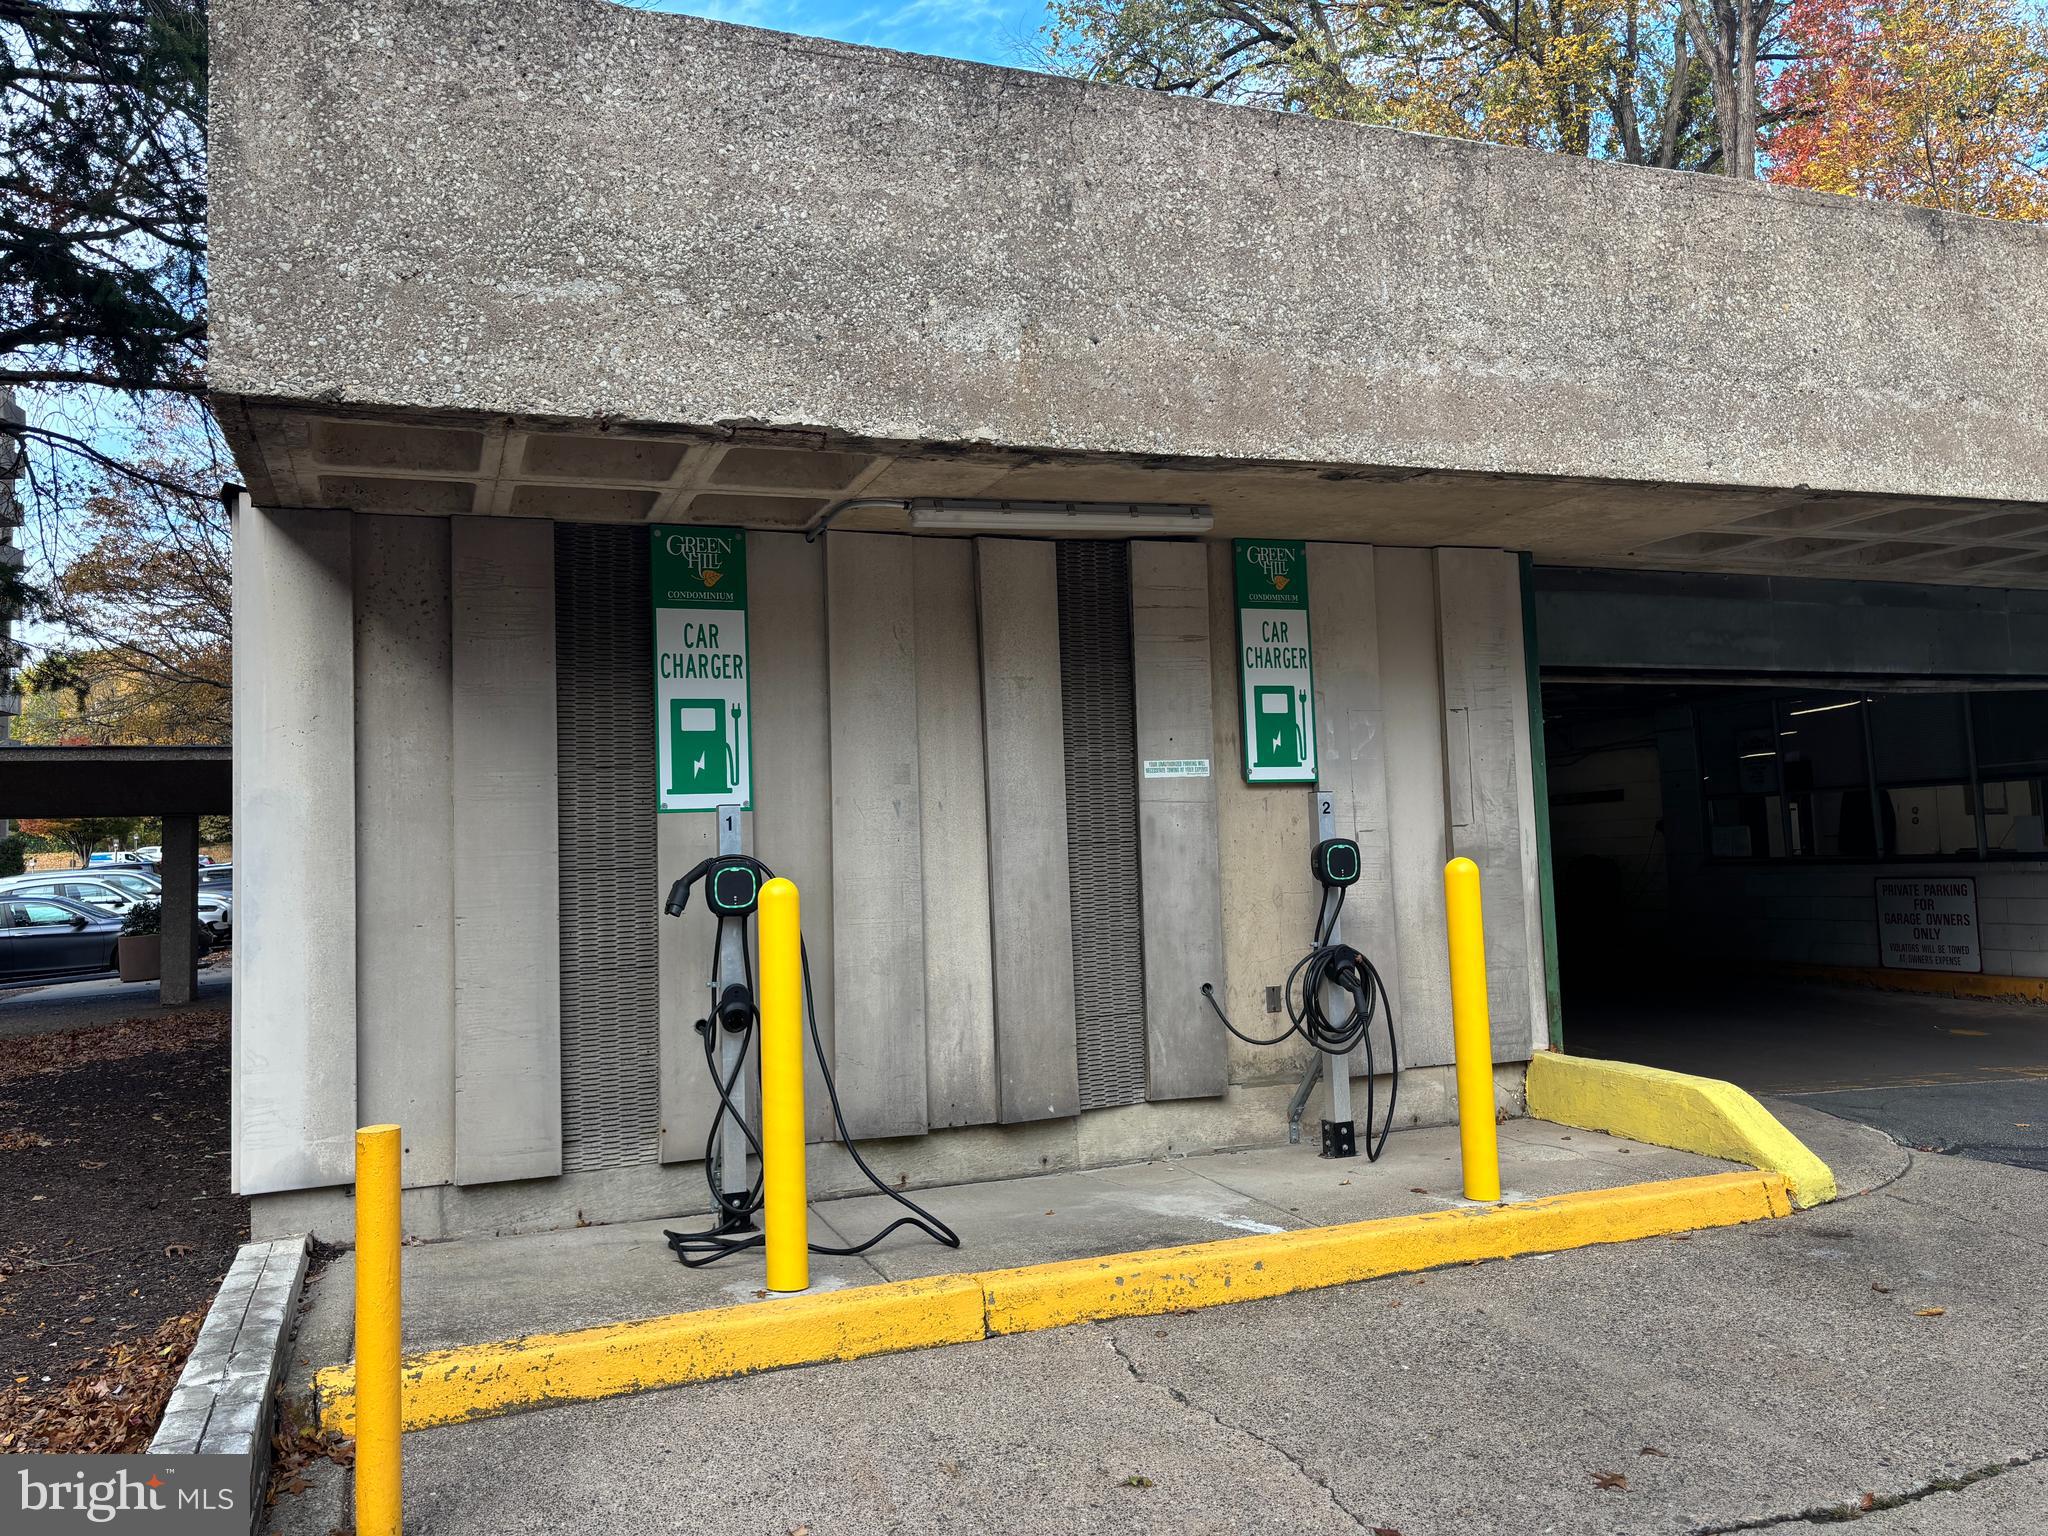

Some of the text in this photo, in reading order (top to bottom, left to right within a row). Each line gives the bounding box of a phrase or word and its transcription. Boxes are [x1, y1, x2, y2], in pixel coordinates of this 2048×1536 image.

[666, 534, 732, 558] GREEN
[1246, 545, 1296, 564] GREEN
[687, 552, 723, 577] HILL
[1262, 560, 1289, 581] HILL
[667, 590, 734, 600] CONDOMINIUM
[1248, 593, 1299, 602] CONDOMINIUM
[683, 622, 719, 649] CAR
[1261, 620, 1289, 643] CAR
[1245, 646, 1308, 670] CHARGER
[660, 652, 744, 680] CHARGER
[1322, 801, 1331, 815] 2
[725, 816, 732, 831] 1
[1881, 883, 1968, 897] PRIVATE PARKING
[1913, 898, 1935, 911] FOR
[1884, 912, 1971, 927] GARAGE OWNERS
[1913, 927, 1941, 941] ONLY
[1889, 943, 1970, 955] VIOLATORS WILL BE TOWED
[1935, 955, 1961, 966] EXPENSE
